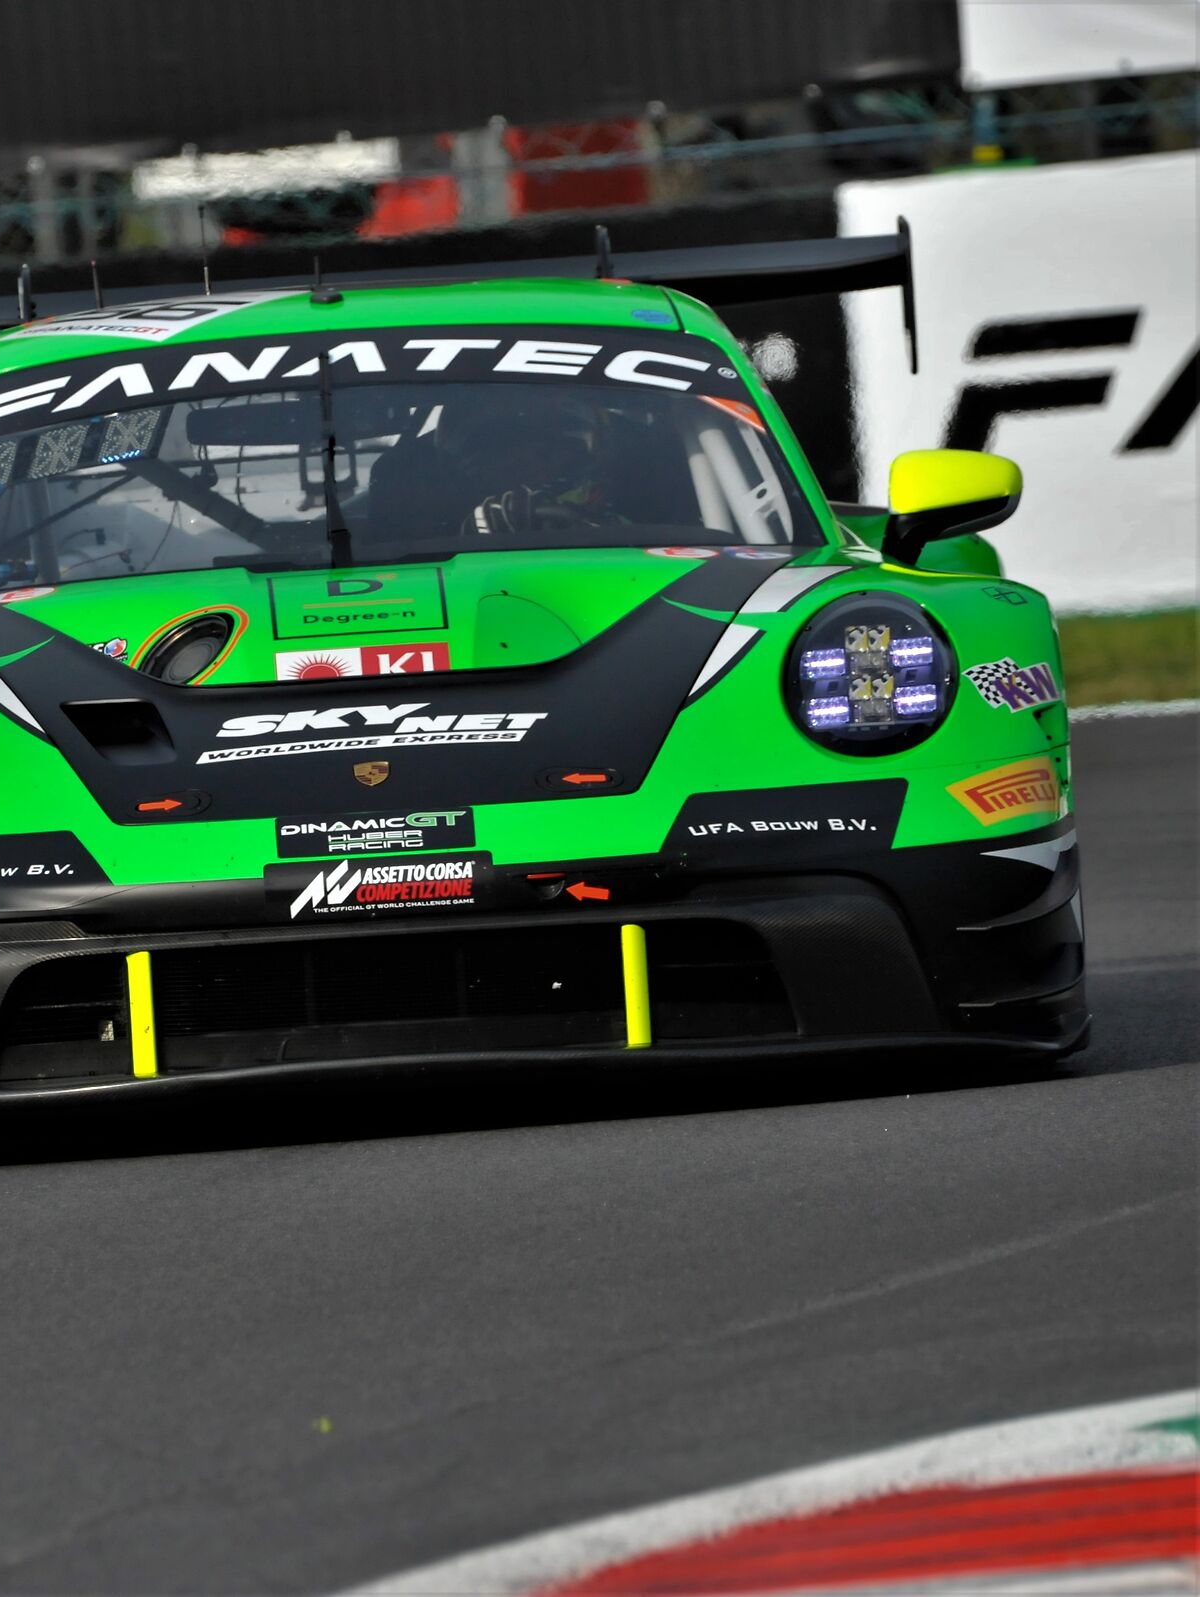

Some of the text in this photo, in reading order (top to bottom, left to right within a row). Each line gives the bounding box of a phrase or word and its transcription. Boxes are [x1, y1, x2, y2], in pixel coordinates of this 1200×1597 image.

[303, 610, 416, 625] Degree-n
[993, 662, 1060, 711] KW
[207, 731, 519, 762] WORLDWIDE EXPRESS
[963, 768, 1057, 815] PIRELLI
[327, 829, 424, 843] HUBER
[687, 822, 745, 837] UFA
[827, 818, 877, 832] B.V.
[26, 863, 75, 876] B.V.
[362, 861, 474, 885] ASSETTO CORSA
[355, 879, 473, 903] COMPETIZIONE
[329, 905, 365, 913] OFFICIAL
[377, 902, 405, 910] WORLD
[405, 900, 452, 909] CHALLENGE
